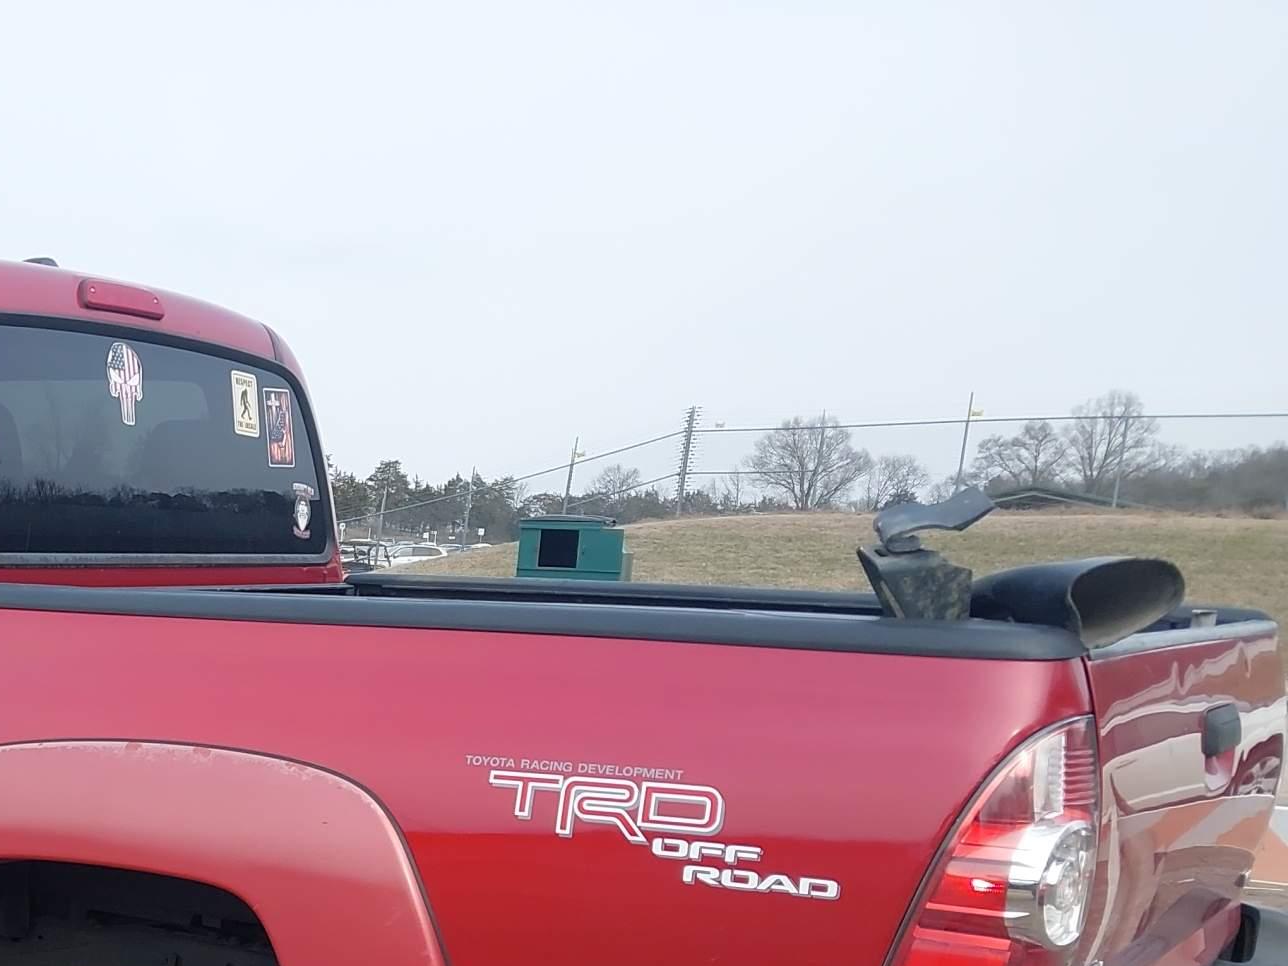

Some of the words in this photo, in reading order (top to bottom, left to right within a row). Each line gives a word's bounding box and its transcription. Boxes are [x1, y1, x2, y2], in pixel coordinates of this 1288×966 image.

[465, 755, 516, 769] TOYOTA
[520, 758, 574, 773] RACING
[578, 763, 685, 781] DEVELOPMENT
[489, 770, 726, 843] TRD
[652, 837, 764, 865] OFF
[682, 865, 841, 901] ROAD
